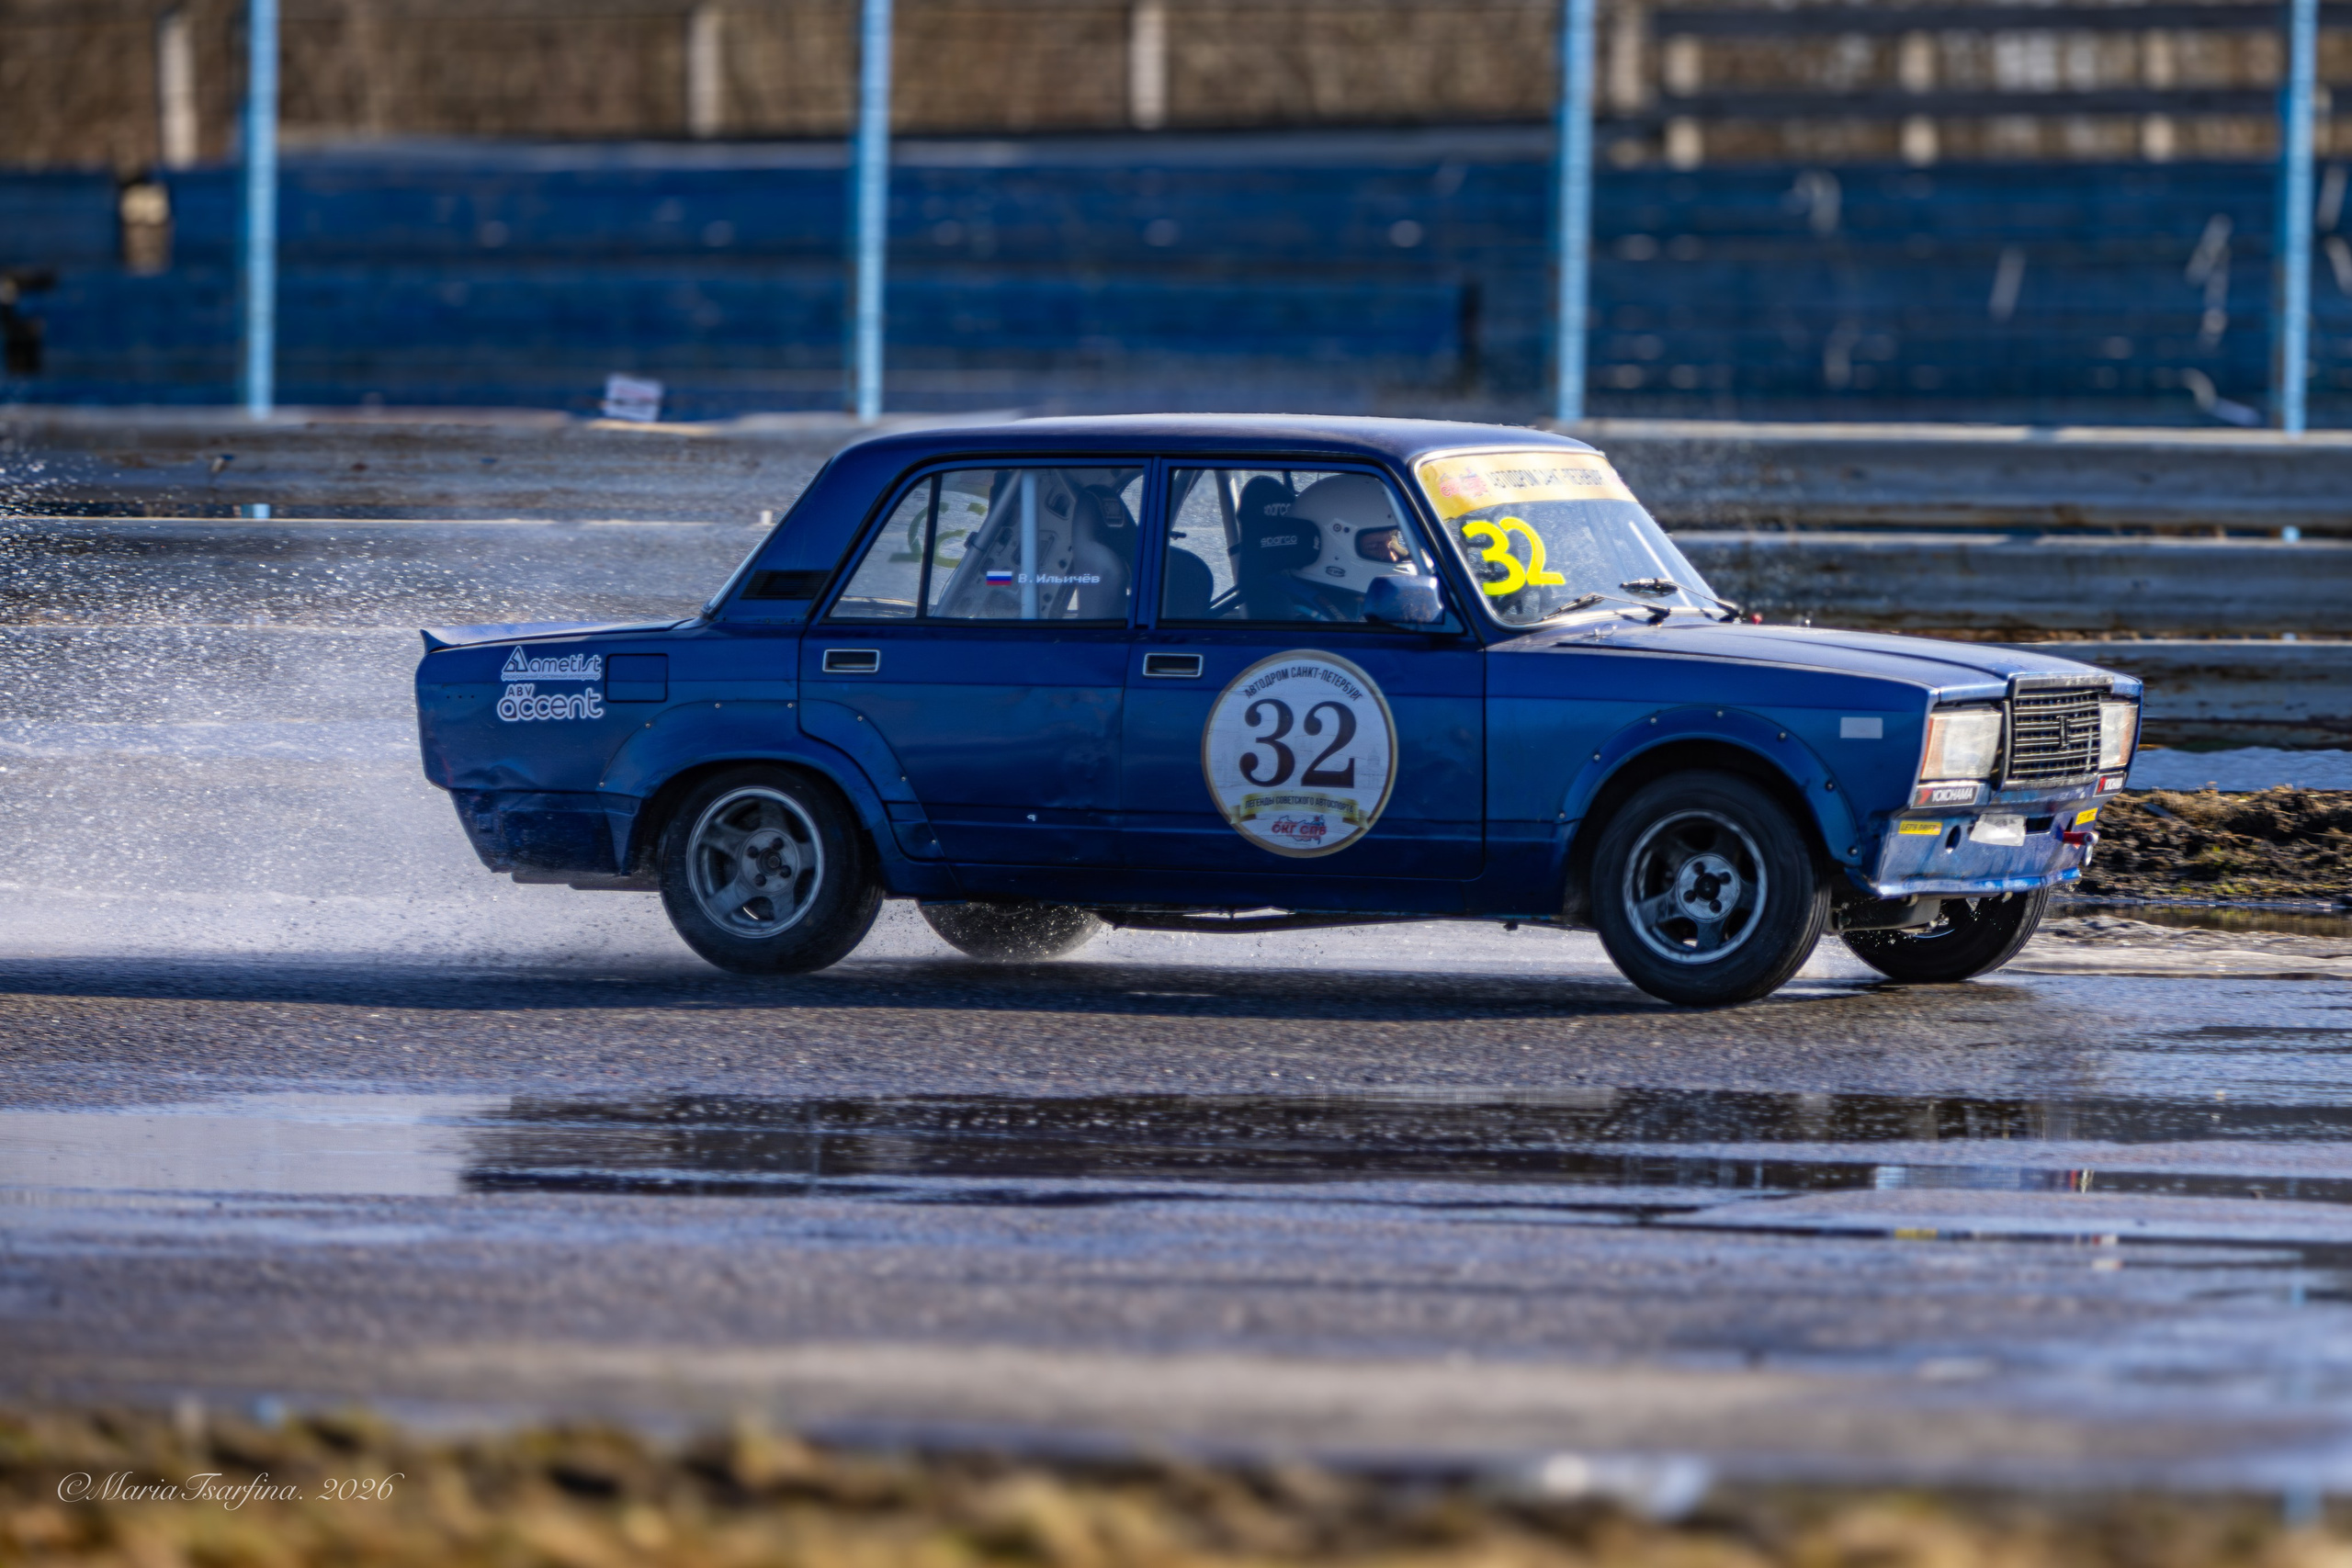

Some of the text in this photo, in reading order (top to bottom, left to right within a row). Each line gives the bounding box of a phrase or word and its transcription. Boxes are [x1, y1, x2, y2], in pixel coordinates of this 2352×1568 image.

[1260, 536, 1297, 547] sparco
[1462, 516, 1566, 596] 32
[529, 654, 602, 672] ametist
[507, 686, 534, 697] ABV
[1244, 666, 1363, 702] АВТОДРОМ САНКТ-ПЕТЕРБУРГ
[499, 690, 603, 719] accent
[1239, 698, 1357, 789] 32
[1932, 787, 1973, 802] YOKOHAMA
[1245, 795, 1354, 814] ЛЕГЕНДЫ СОВЕТСКОГО АВТОСПОРТА
